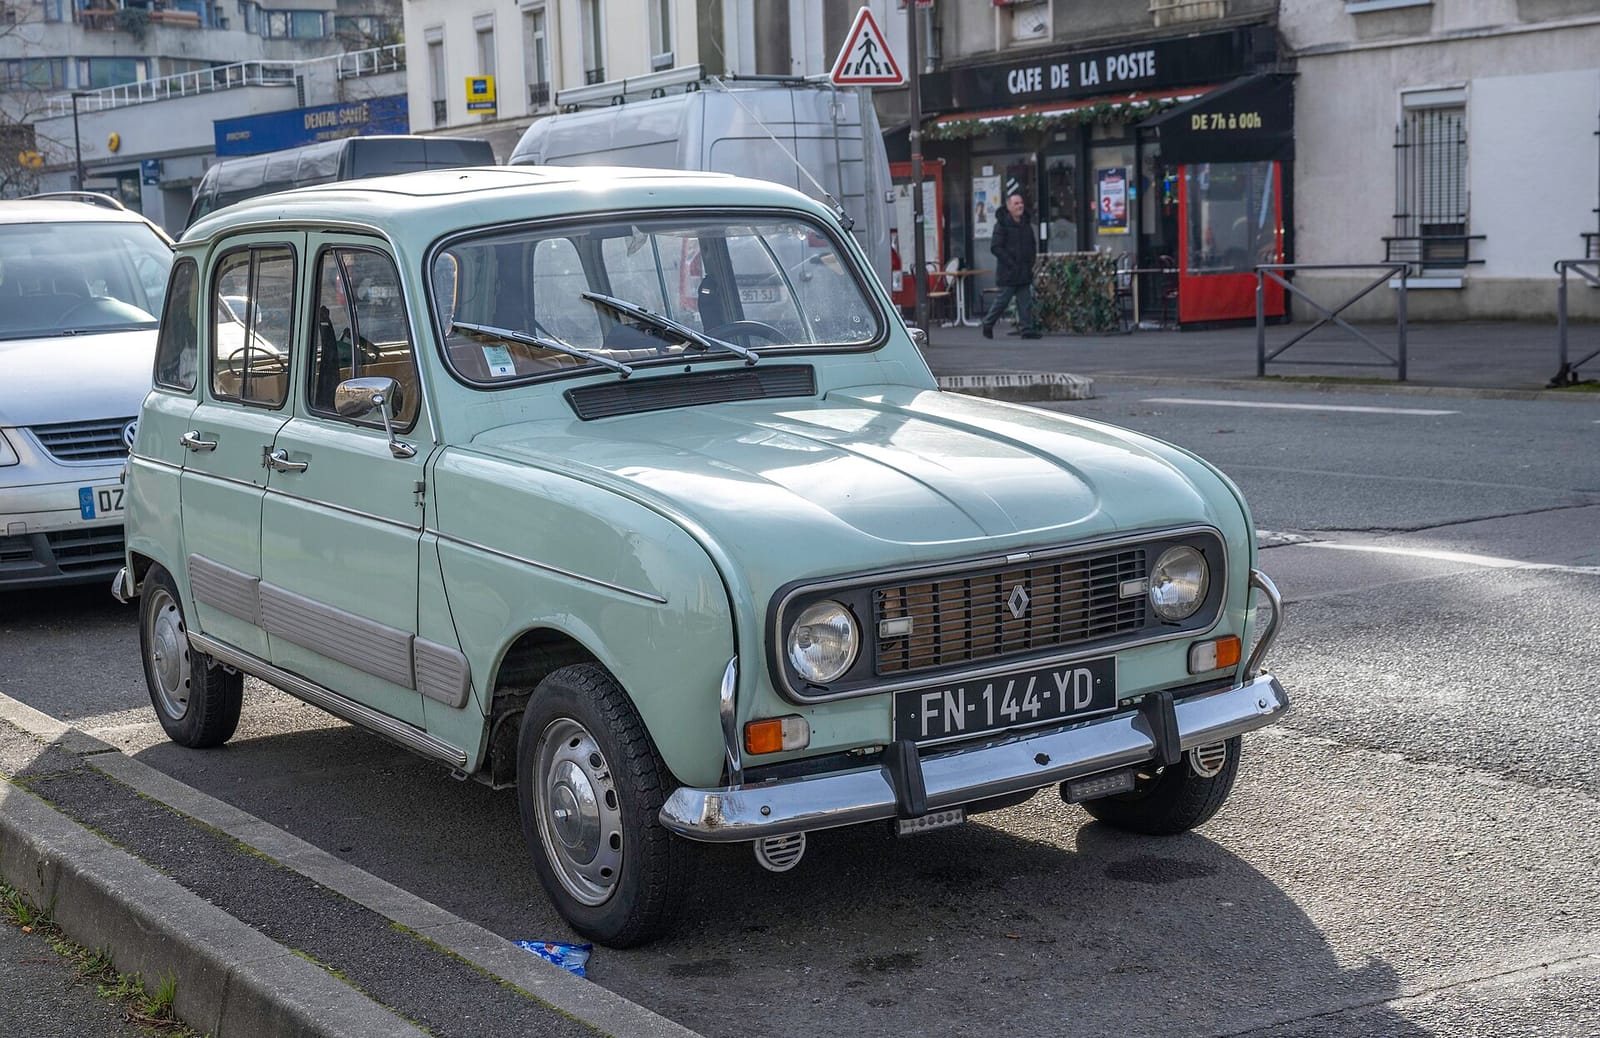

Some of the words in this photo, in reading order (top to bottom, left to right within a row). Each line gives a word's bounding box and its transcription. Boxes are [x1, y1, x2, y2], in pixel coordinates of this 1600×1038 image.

[1008, 67, 1042, 94] CAFE
[1050, 63, 1070, 89] DE
[1080, 60, 1100, 86] LA
[1106, 50, 1156, 82] POSTE
[304, 111, 337, 130] DENTAL
[1192, 114, 1208, 130] DE
[1210, 112, 1226, 130] 7h
[1228, 113, 1237, 129] à
[1239, 112, 1262, 129] 00h
[98, 489, 124, 512] DZ
[921, 668, 1093, 737] FN-144-YD
